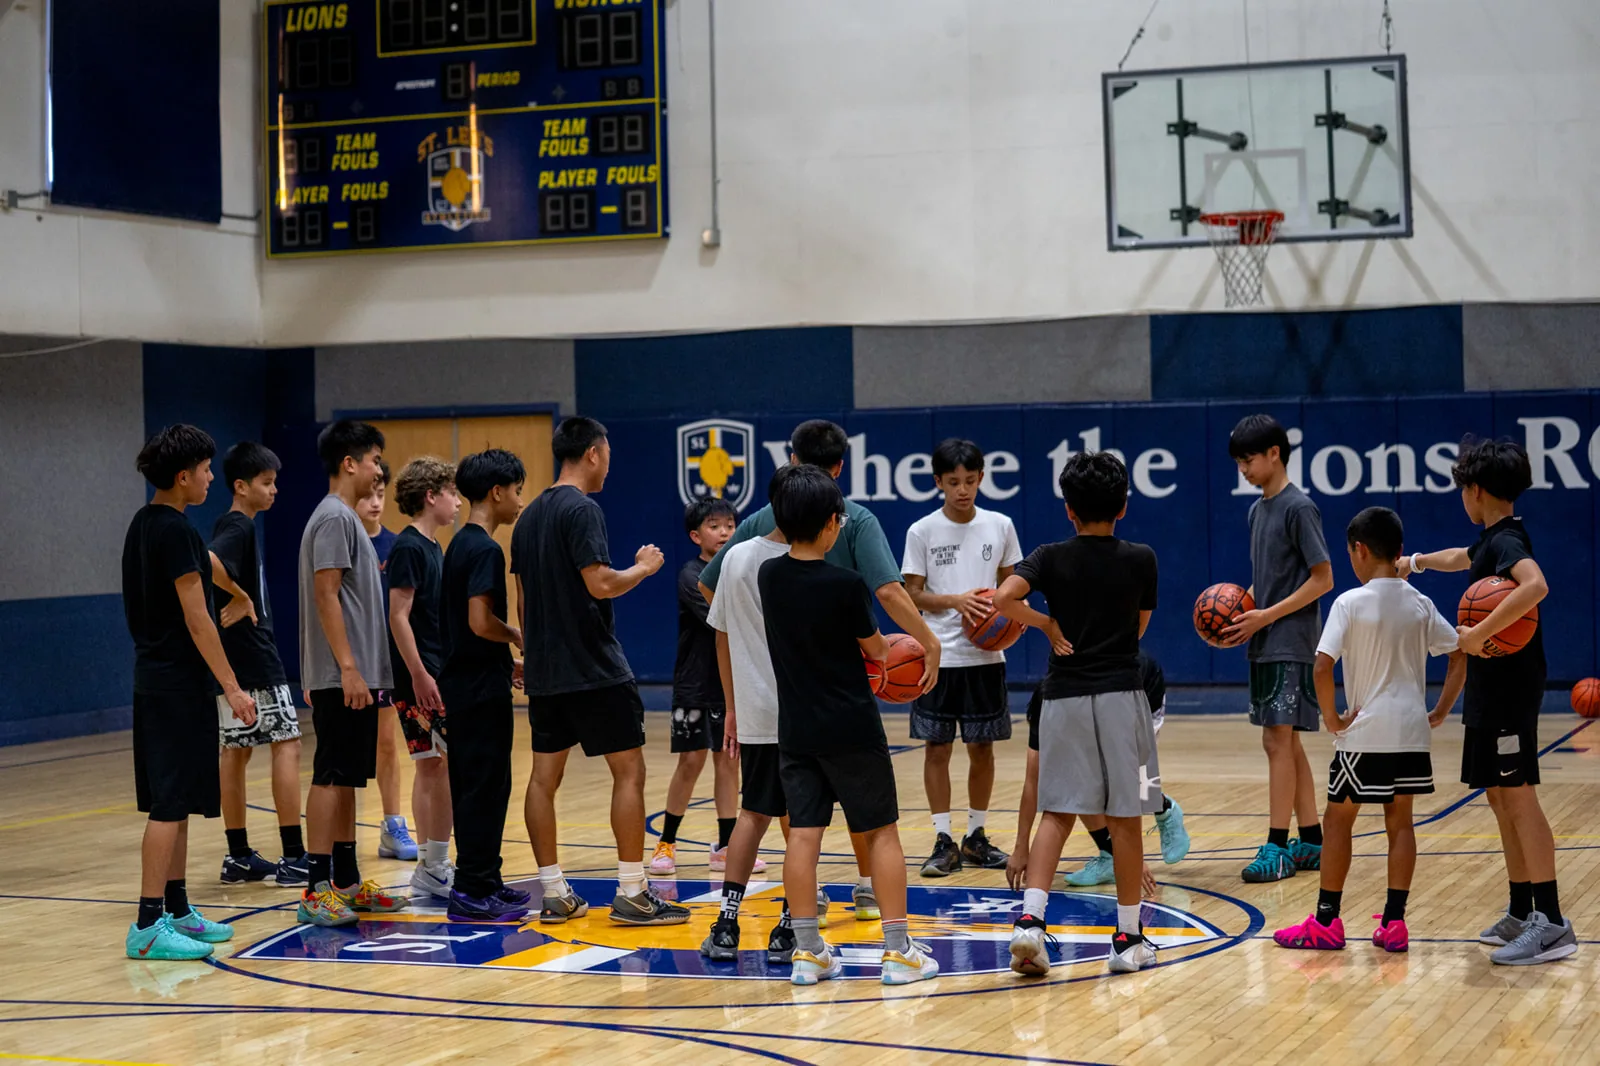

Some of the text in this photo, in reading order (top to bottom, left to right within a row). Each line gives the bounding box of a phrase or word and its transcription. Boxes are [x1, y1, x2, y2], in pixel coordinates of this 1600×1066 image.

[286, 3, 348, 32] LIONS
[477, 70, 520, 87] PERIOD
[543, 118, 587, 138] TEAM
[336, 132, 377, 152] TEAM
[538, 137, 590, 158] FOULS
[331, 151, 379, 171] FOULS
[538, 164, 658, 189] PLAYER FOULS
[341, 181, 389, 202] FOULS
[762, 432, 1020, 502] hee
[930, 544, 961, 554] SHOWTIME
[935, 558, 957, 566] SUNSET
